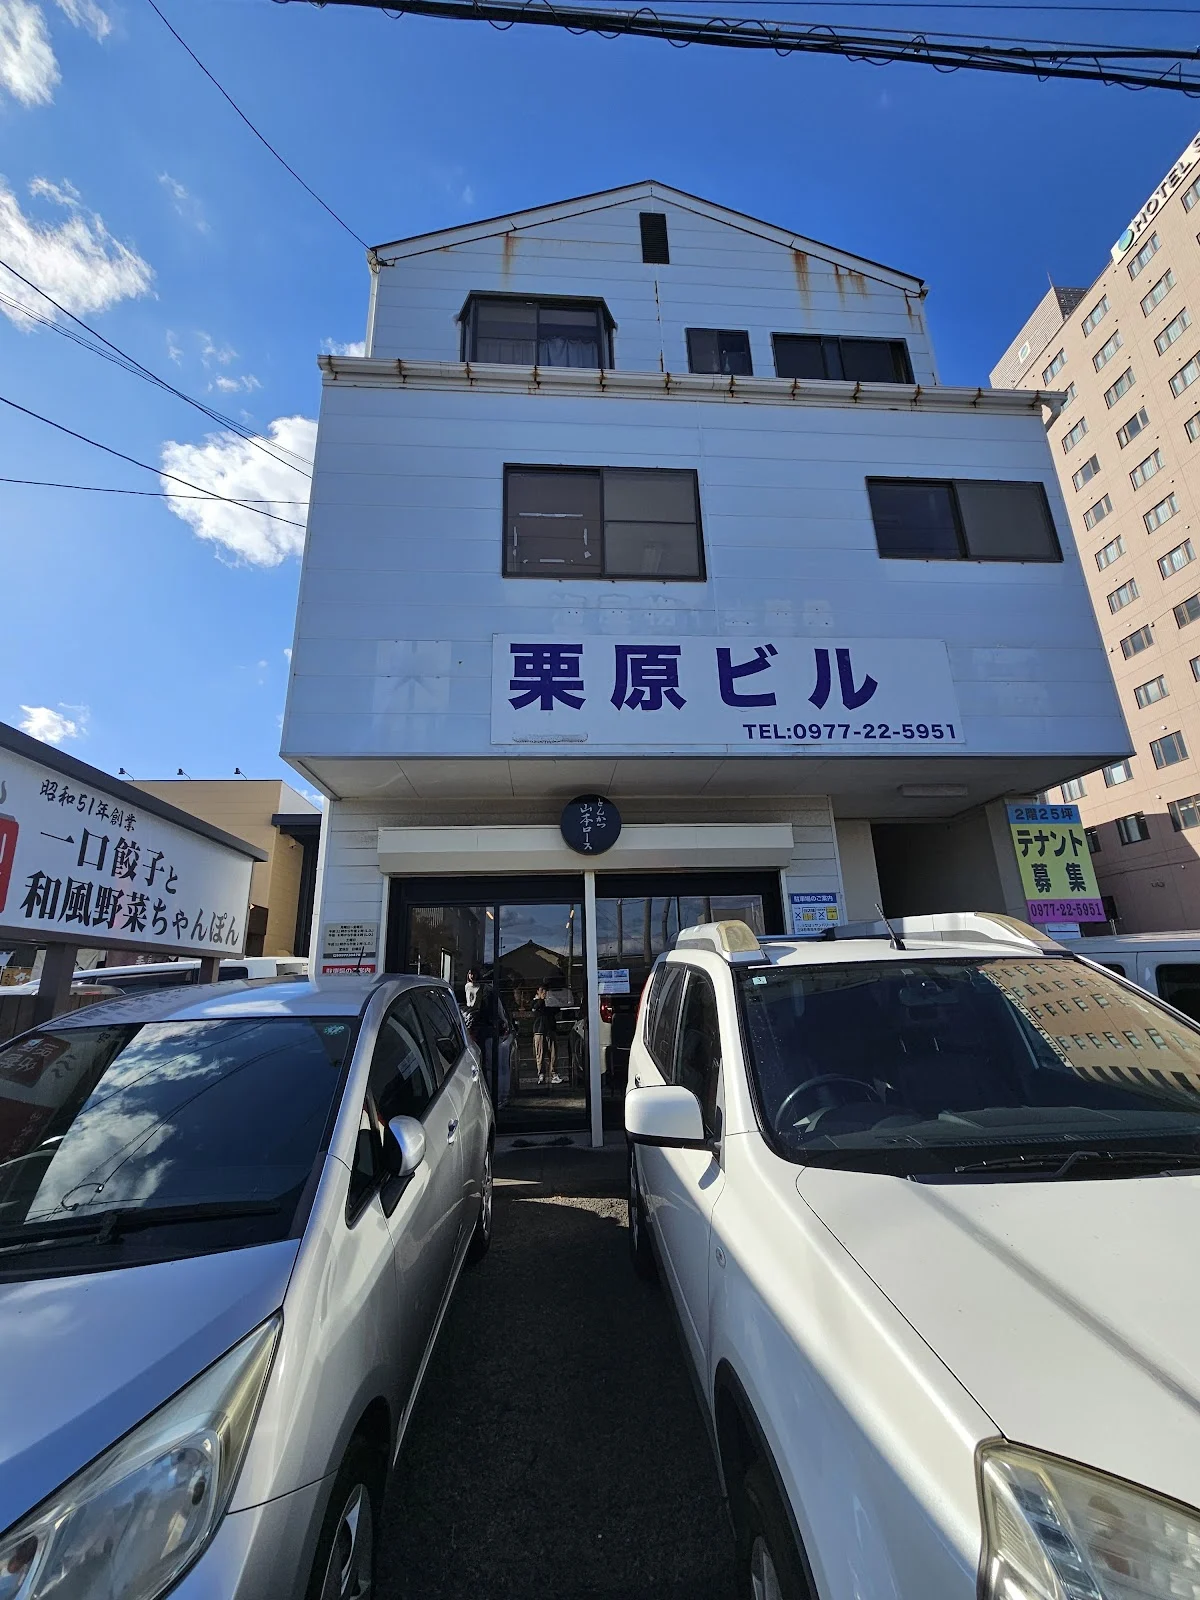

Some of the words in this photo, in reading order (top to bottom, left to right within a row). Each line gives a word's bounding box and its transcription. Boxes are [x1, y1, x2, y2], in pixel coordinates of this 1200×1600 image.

[1133, 161, 1192, 232] HOTEL
[508, 643, 878, 711] 栗原ビル
[743, 723, 957, 741] TEL:0977-22-5951
[39, 779, 137, 832] 昭和51年創業
[595, 798, 607, 829] とんかつ
[1014, 808, 1073, 821] 2階25坪
[579, 804, 594, 850] 山本ロース
[1017, 829, 1083, 858] テナント
[40, 828, 178, 895] 一口餃子と
[1031, 862, 1087, 893] 募集
[20, 870, 240, 946] 和風野菜ちゃんぽん
[1030, 902, 1103, 917] 0977-22-5951
